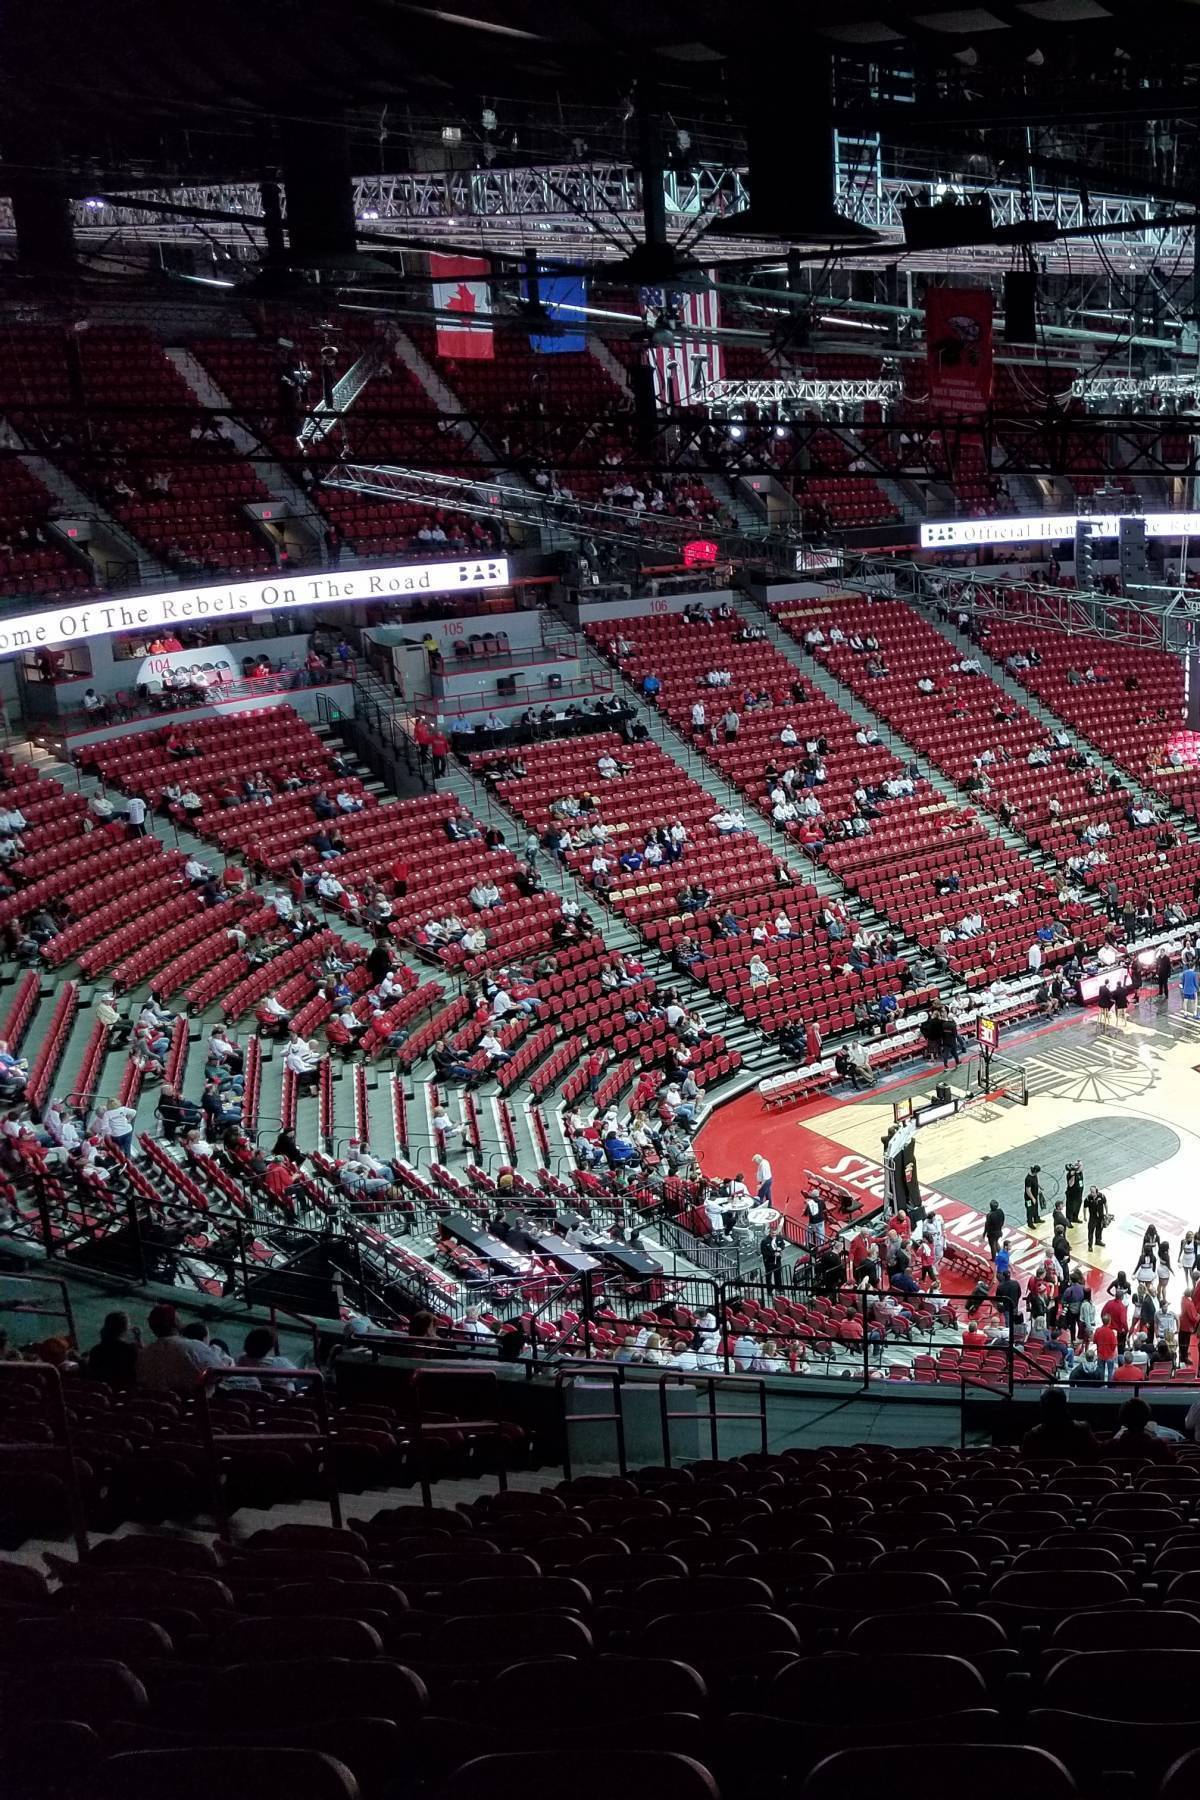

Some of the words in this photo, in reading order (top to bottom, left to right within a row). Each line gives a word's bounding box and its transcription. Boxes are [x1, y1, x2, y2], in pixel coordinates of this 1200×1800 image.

[964, 524, 1031, 541] Official
[60, 611, 91, 636] Of
[100, 607, 150, 628] The
[162, 591, 249, 619] Rebels
[261, 586, 296, 605] On
[308, 580, 354, 599] The
[369, 571, 431, 593] Road
[650, 600, 668, 612] 106
[443, 622, 464, 636] 105
[148, 658, 171, 674] 104
